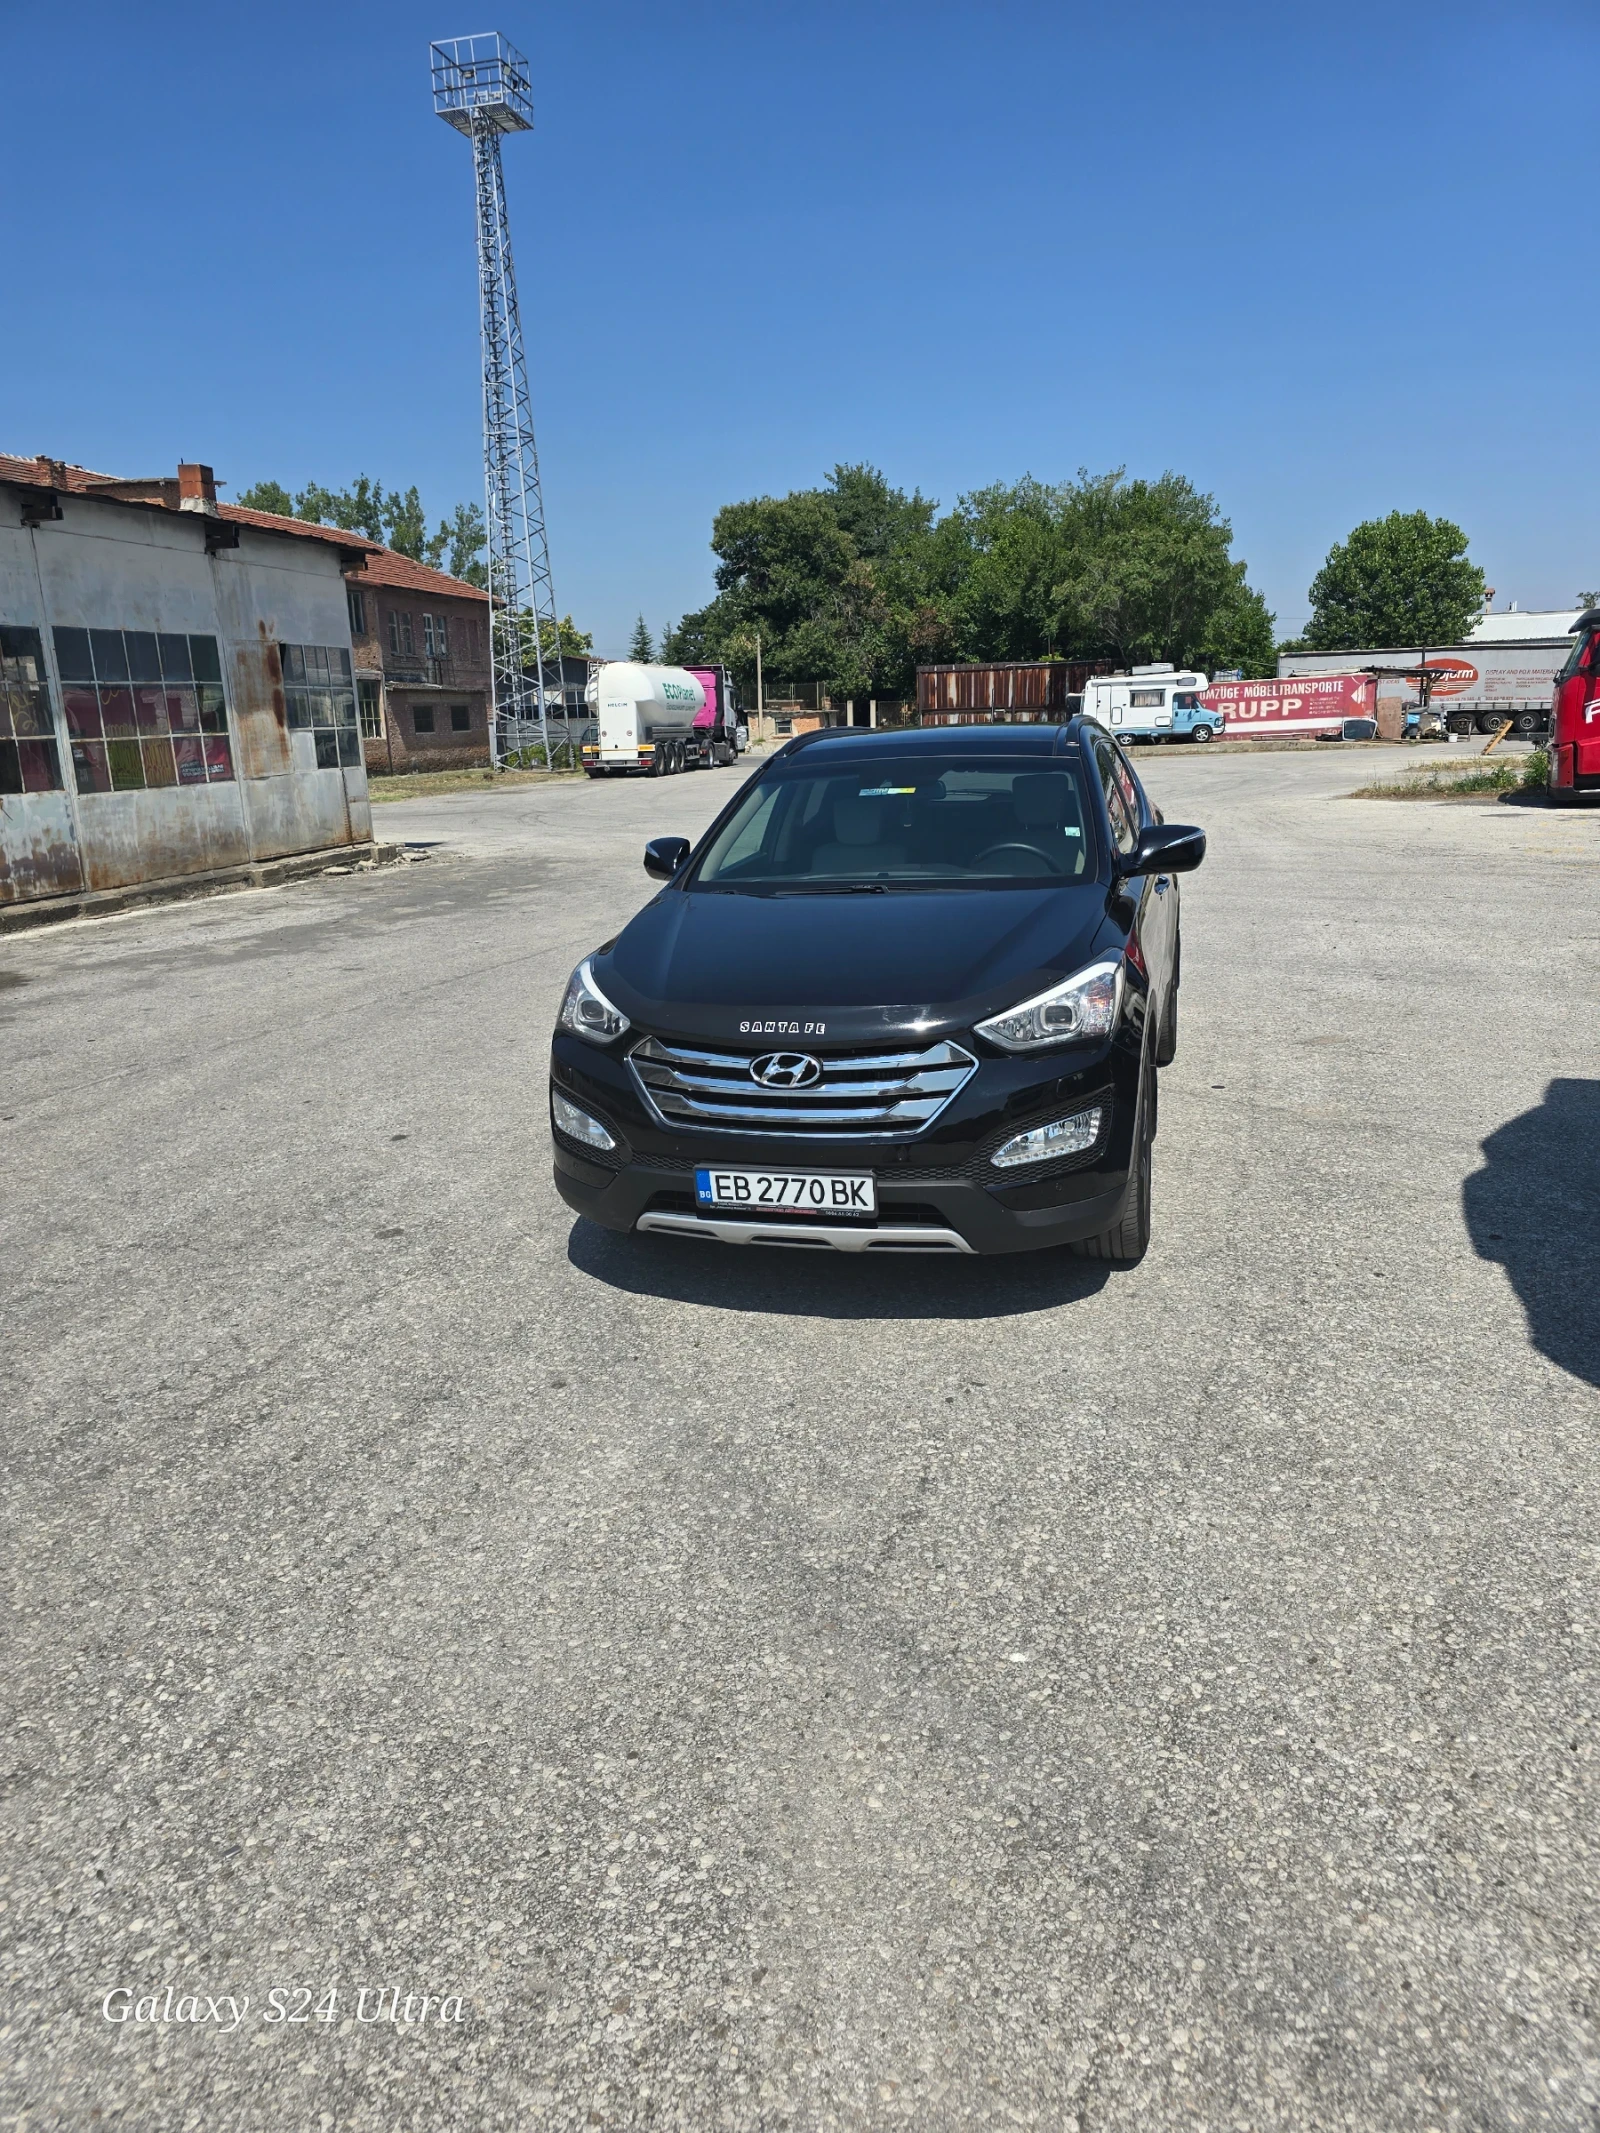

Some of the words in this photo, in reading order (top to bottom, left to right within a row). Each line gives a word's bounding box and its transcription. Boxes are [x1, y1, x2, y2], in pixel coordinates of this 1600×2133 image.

[662, 683, 696, 701] ECOPlanet
[1217, 698, 1303, 719] RUPP
[740, 1021, 799, 1034] SANTA
[804, 1022, 825, 1034] FE
[699, 1190, 711, 1199] BG
[715, 1175, 751, 1201] EB
[756, 1177, 825, 1205] 2770
[831, 1179, 868, 1206] BK
